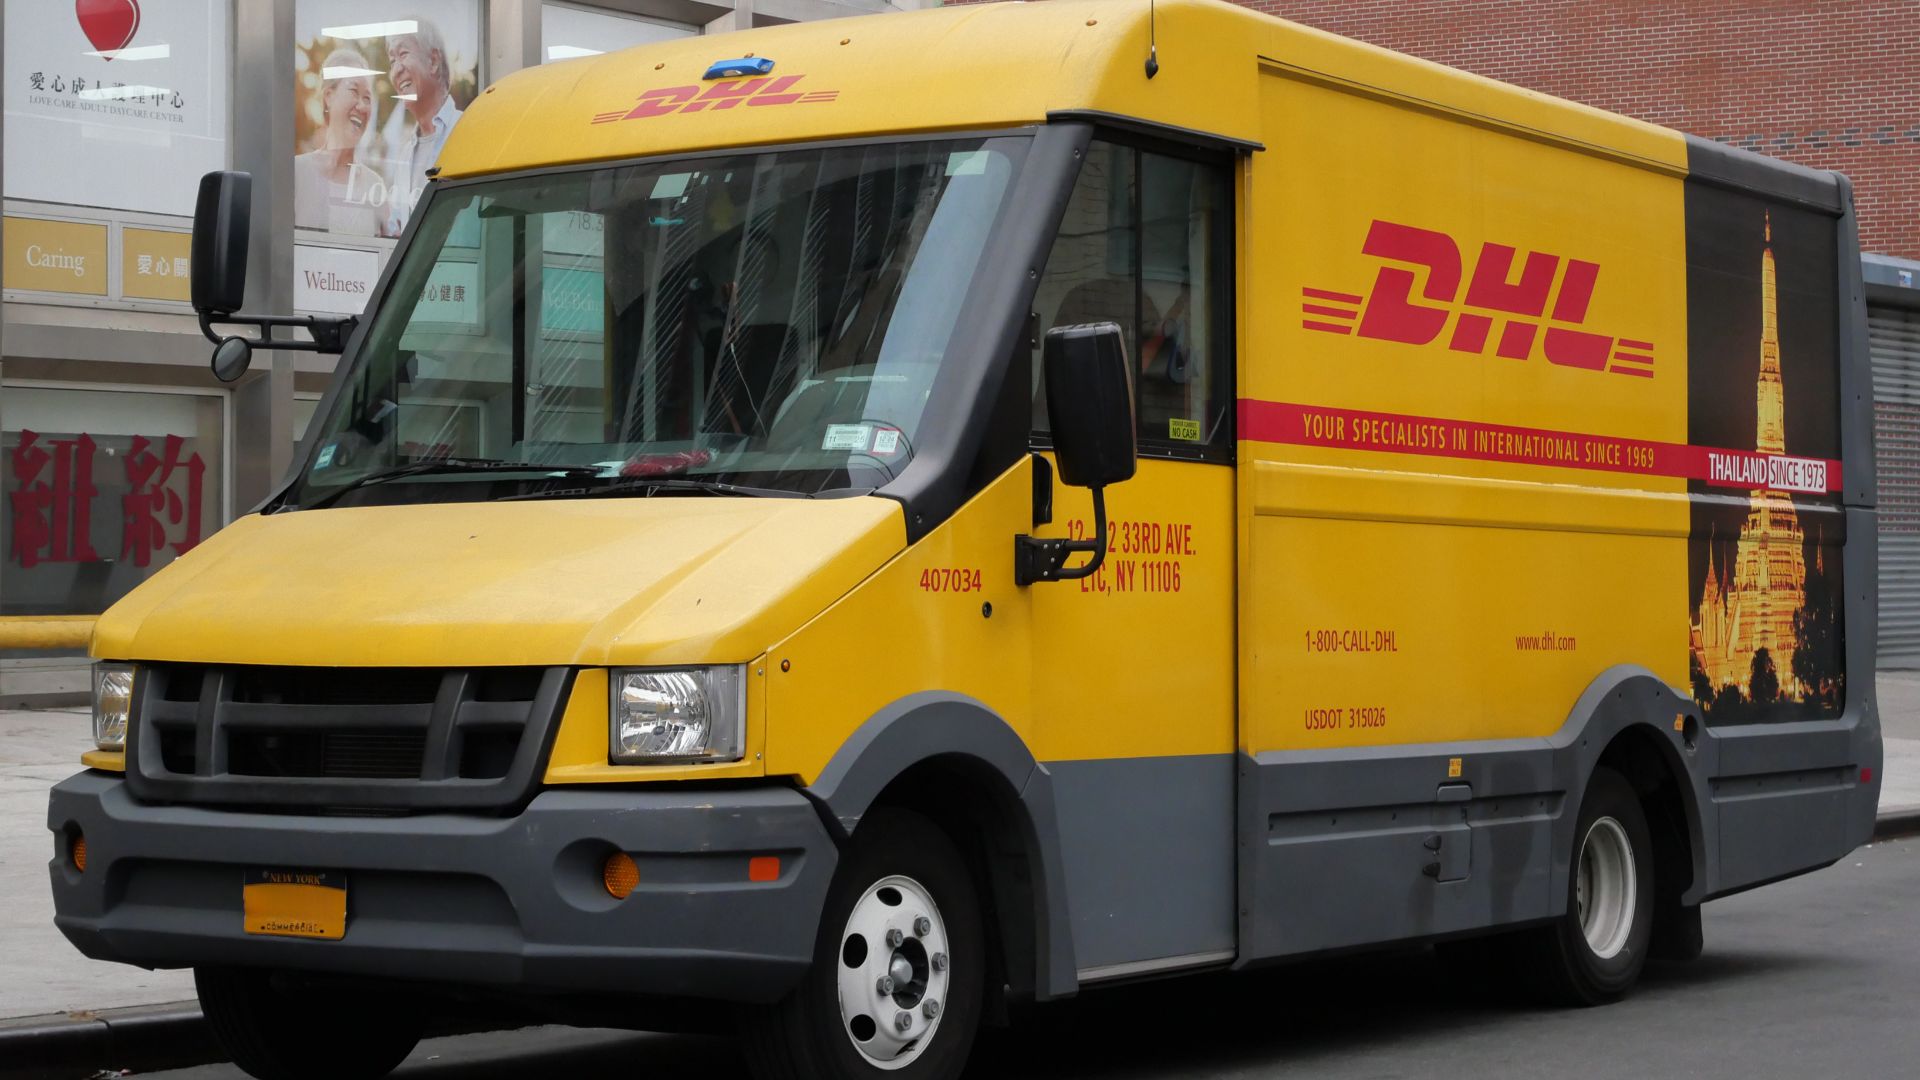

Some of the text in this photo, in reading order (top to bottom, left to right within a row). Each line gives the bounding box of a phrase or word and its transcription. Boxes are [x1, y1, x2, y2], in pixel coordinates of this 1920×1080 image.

[29, 95, 184, 123] LOVE CARE ADULT DAYCARE CENTER
[620, 74, 806, 120] DHL
[26, 245, 85, 277] Caring
[304, 270, 365, 294] Wellness
[1357, 219, 1614, 371] DHL
[1172, 427, 1197, 440] NO CASH
[1303, 413, 1655, 469] YOUR SPECIALISTS IN INTERNATIONAL SINCE 1969
[1708, 453, 1768, 484] THAILAND
[1769, 459, 1825, 489] SINCE 1973
[8, 429, 206, 569] 紐約
[1122, 522, 1161, 554] 33RD
[1165, 523, 1197, 556] AVE.
[919, 568, 982, 592] 407034
[1116, 560, 1136, 592] NY
[1142, 561, 1181, 593] 11106
[1305, 630, 1398, 653] 1-800-CALL-DHL
[1515, 631, 1577, 652] www.dhl.com
[1305, 707, 1386, 730] USDOT 315026
[270, 872, 321, 885] NEW YORK
[266, 922, 319, 934] COMMERCIAL
